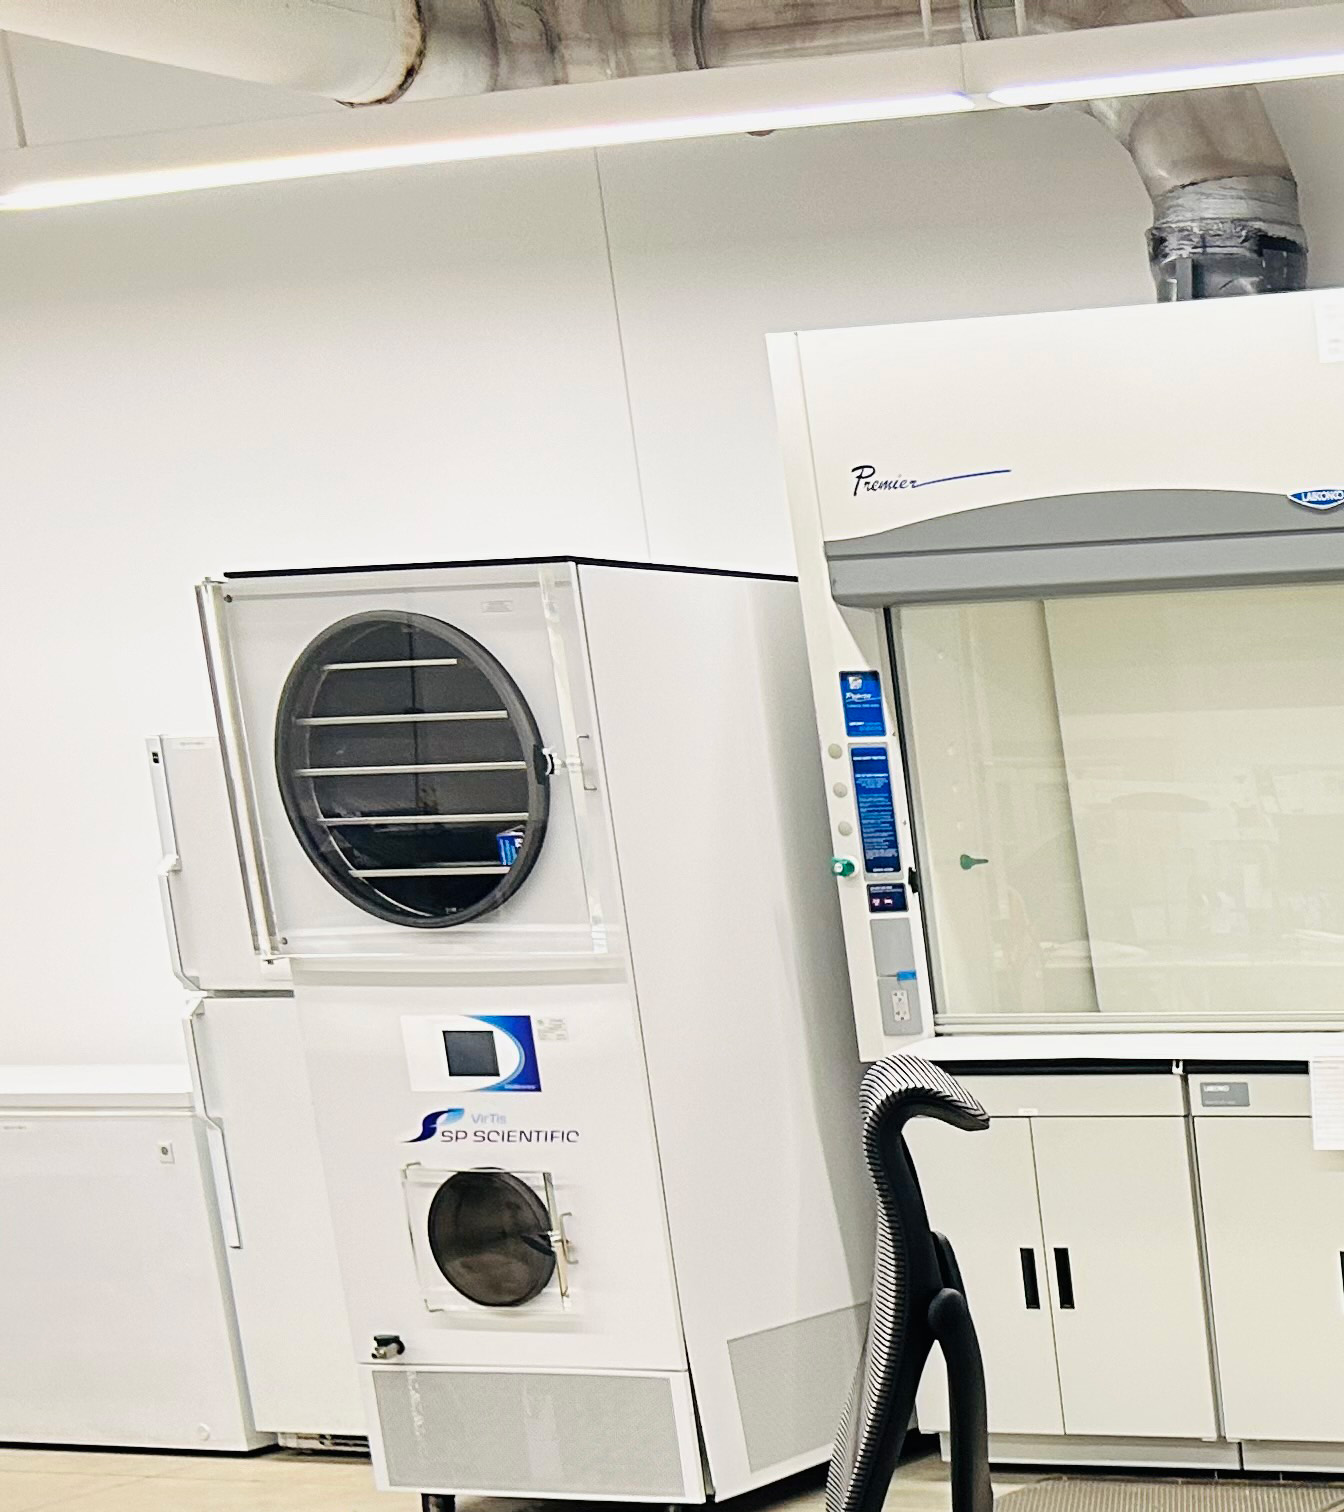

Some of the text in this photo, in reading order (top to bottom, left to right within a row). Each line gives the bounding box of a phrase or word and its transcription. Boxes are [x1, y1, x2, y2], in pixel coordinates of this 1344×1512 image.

[851, 465, 918, 496] Premier
[471, 1113, 507, 1125] VirTis
[441, 1130, 580, 1143] SP SCIENTIFIC
